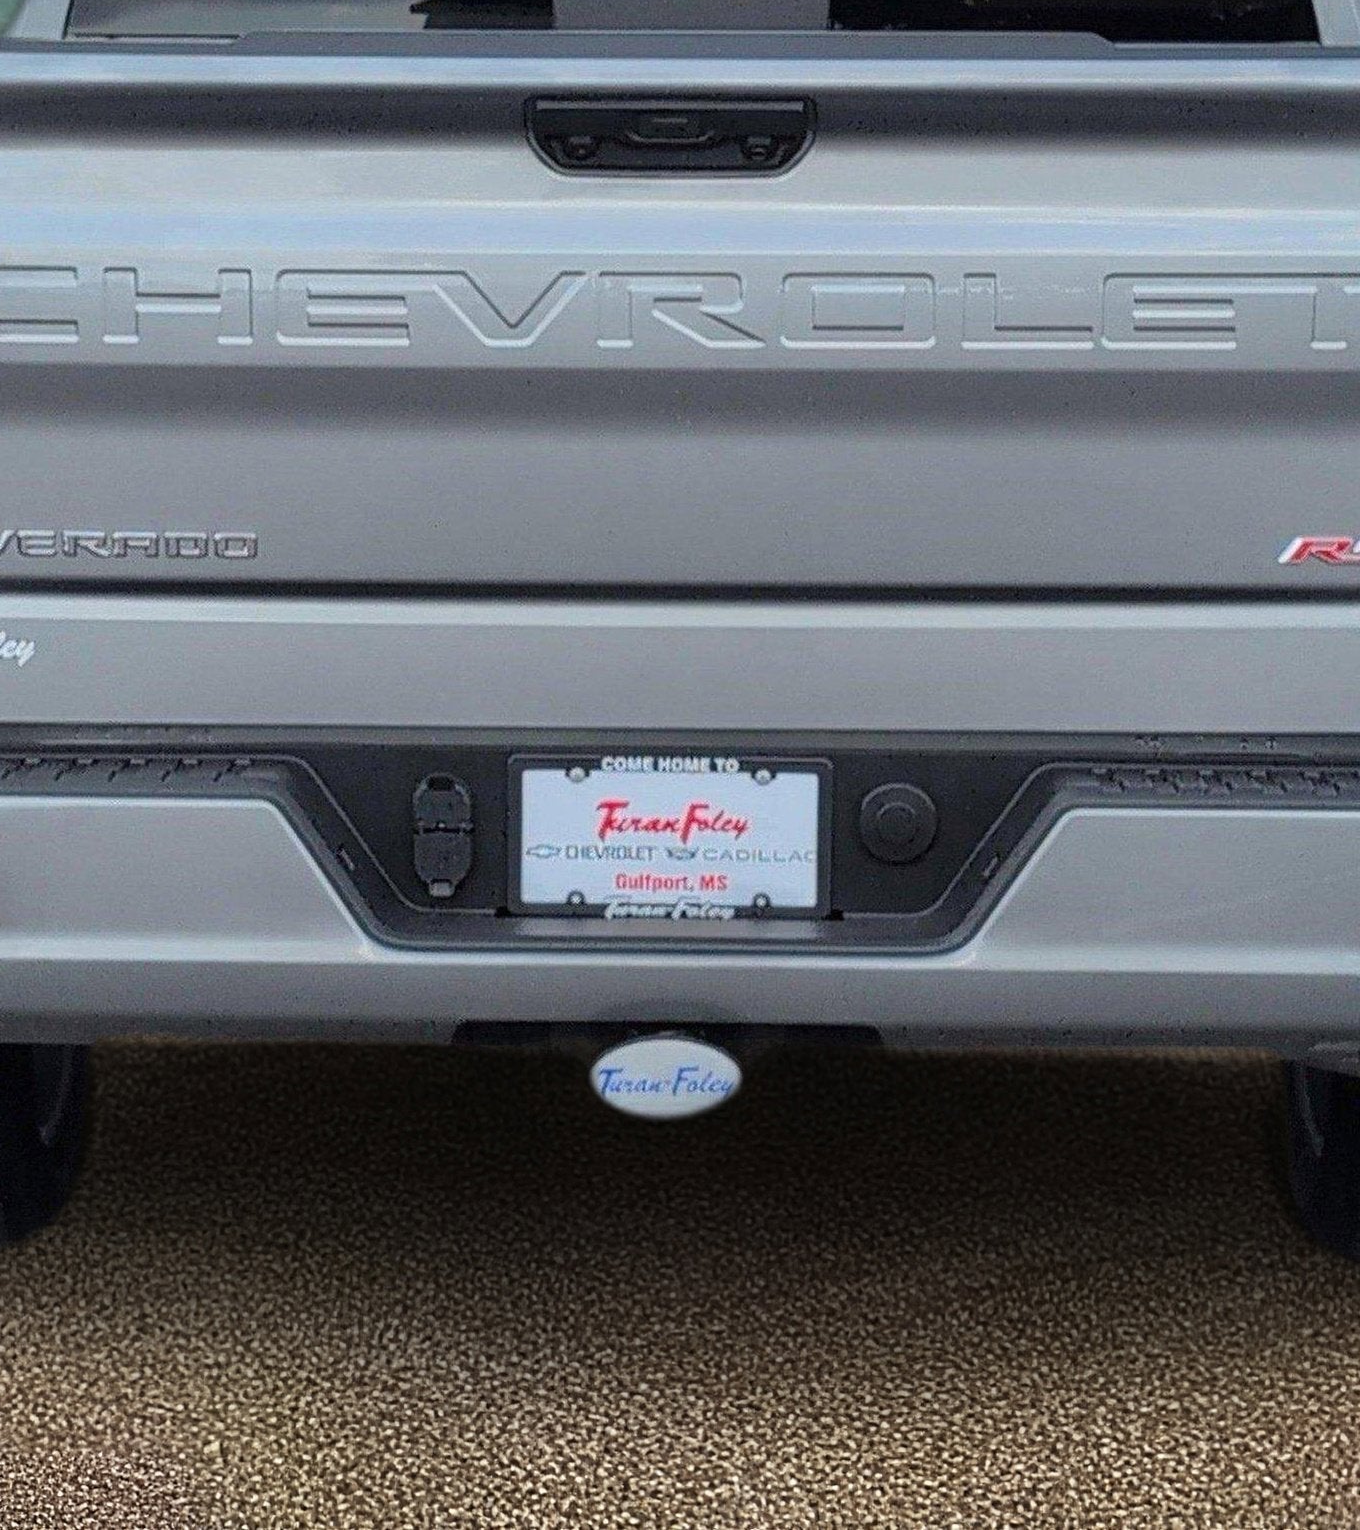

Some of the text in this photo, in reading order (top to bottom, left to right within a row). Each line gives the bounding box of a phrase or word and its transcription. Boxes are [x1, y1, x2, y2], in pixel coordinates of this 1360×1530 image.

[601, 756, 740, 772] COME HOME TO
[565, 845, 816, 863] CHEVROLET CADILLAC
[700, 874, 728, 890] MS
